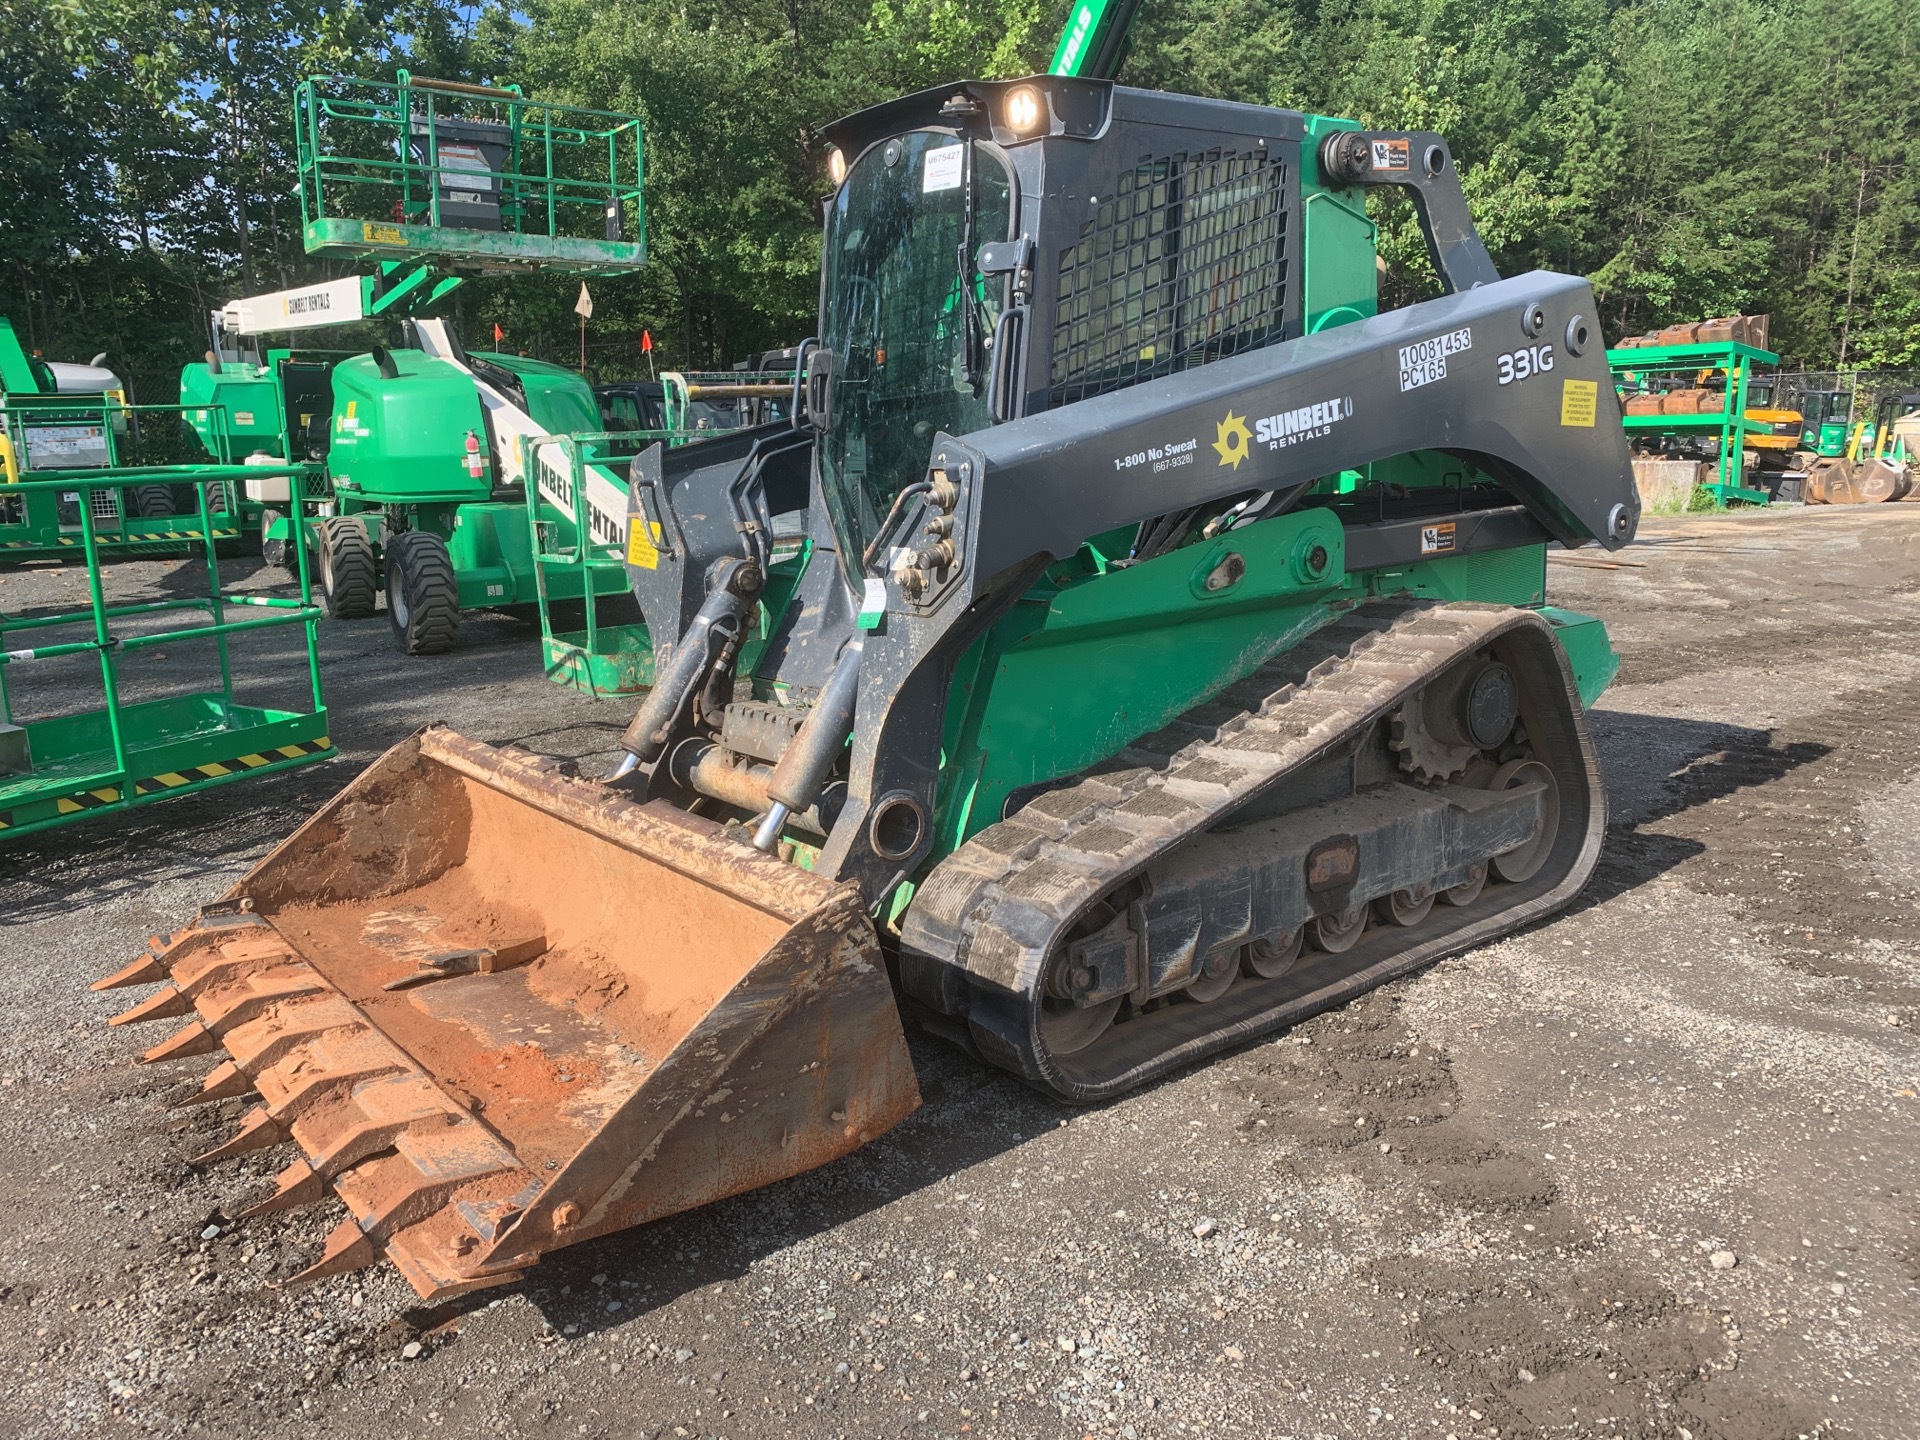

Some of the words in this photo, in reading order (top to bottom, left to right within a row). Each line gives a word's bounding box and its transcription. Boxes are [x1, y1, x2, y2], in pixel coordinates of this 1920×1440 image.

[928, 150, 961, 165] U675427
[289, 297, 308, 315] SUNBELT
[309, 292, 330, 311] RENTALS
[1401, 329, 1471, 368] 10081453
[1497, 344, 1554, 386] 331G
[1401, 358, 1446, 391] PC165
[1255, 398, 1341, 444] SUNBELT
[1113, 451, 1146, 471] 1-800
[1147, 447, 1163, 462] No
[1164, 437, 1197, 456] Sweat
[1269, 425, 1331, 451] RENTALS
[1152, 452, 1194, 474] (667-9328)
